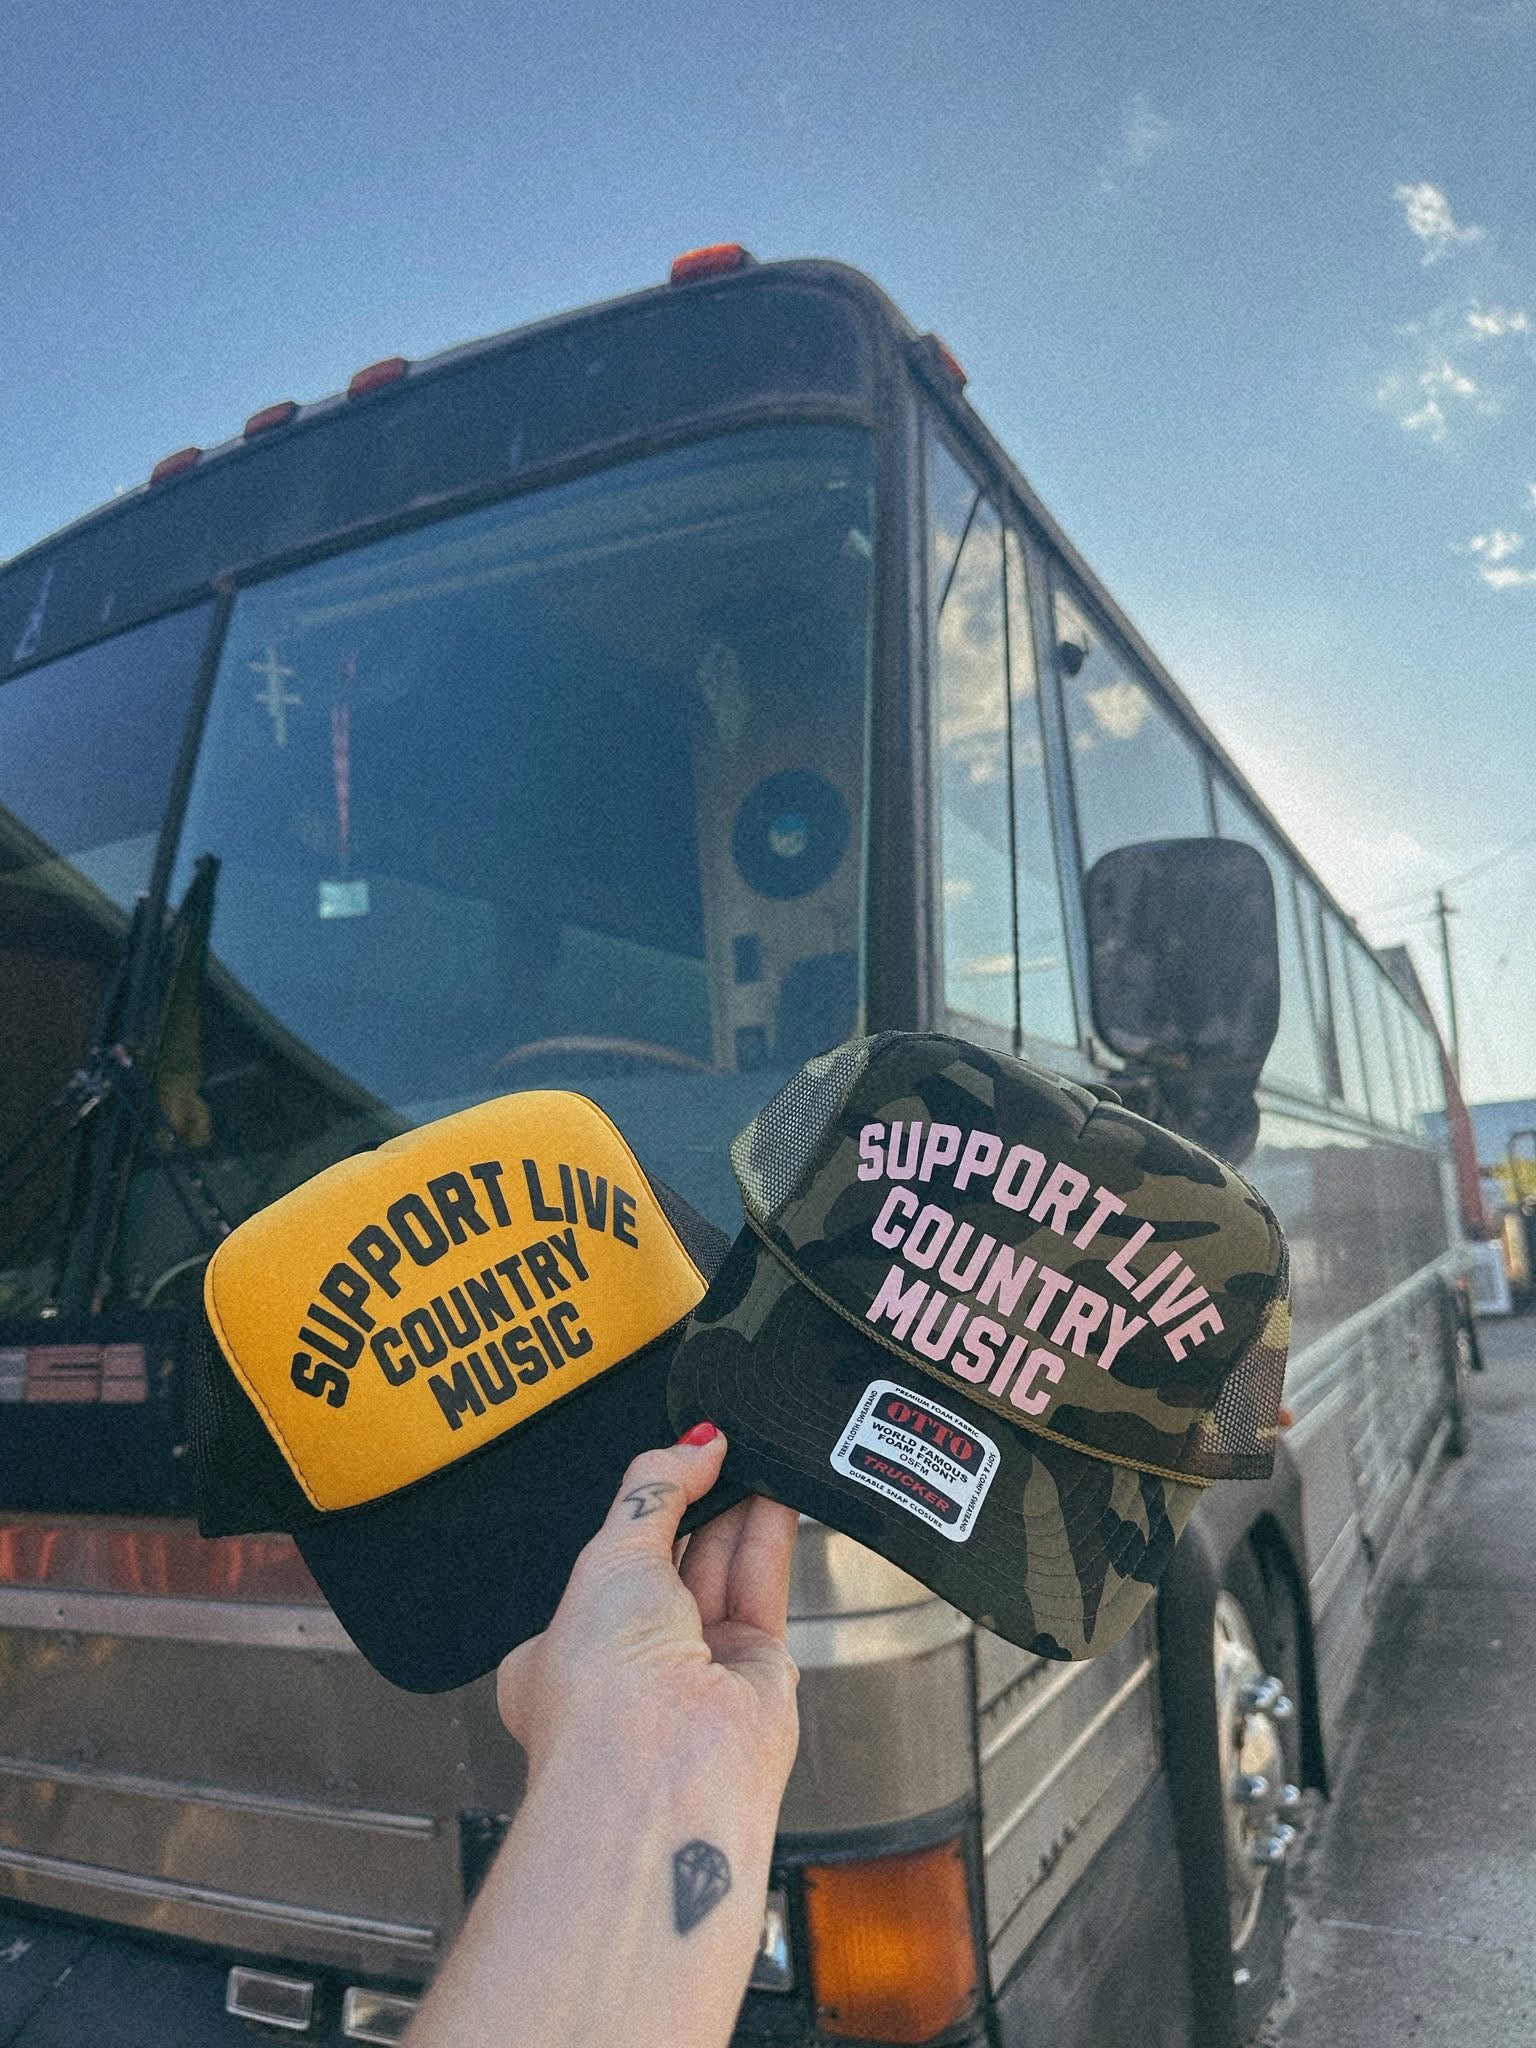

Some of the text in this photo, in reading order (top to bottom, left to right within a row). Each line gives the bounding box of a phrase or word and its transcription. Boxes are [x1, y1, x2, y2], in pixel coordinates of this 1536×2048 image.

[858, 1121, 1225, 1362] SUPPORT LIVE
[291, 1159, 639, 1408] SUPPORT LIVE
[370, 1227, 589, 1386] COUNTRY
[872, 1185, 1148, 1371] COUNTRY
[427, 1301, 593, 1431] MUSIC
[865, 1264, 1066, 1416] MUSIC
[838, 1390, 878, 1457] TERRY CLOTH SWEATBAND
[887, 1401, 973, 1460] OTTO
[896, 1387, 980, 1438] PREMIUM FOAM FABRIC
[872, 1421, 969, 1484] WORLD FAMOUS
[877, 1433, 957, 1484] FOAM FRONT
[900, 1453, 930, 1476] OSFM
[986, 1452, 997, 1468] SOFT
[849, 1469, 944, 1529] DURABLE SNAP CLOSURE
[864, 1455, 950, 1513] TRUCKER
[959, 1495, 978, 1532] SWEATBAND
[975, 1473, 988, 1496] COMFY
